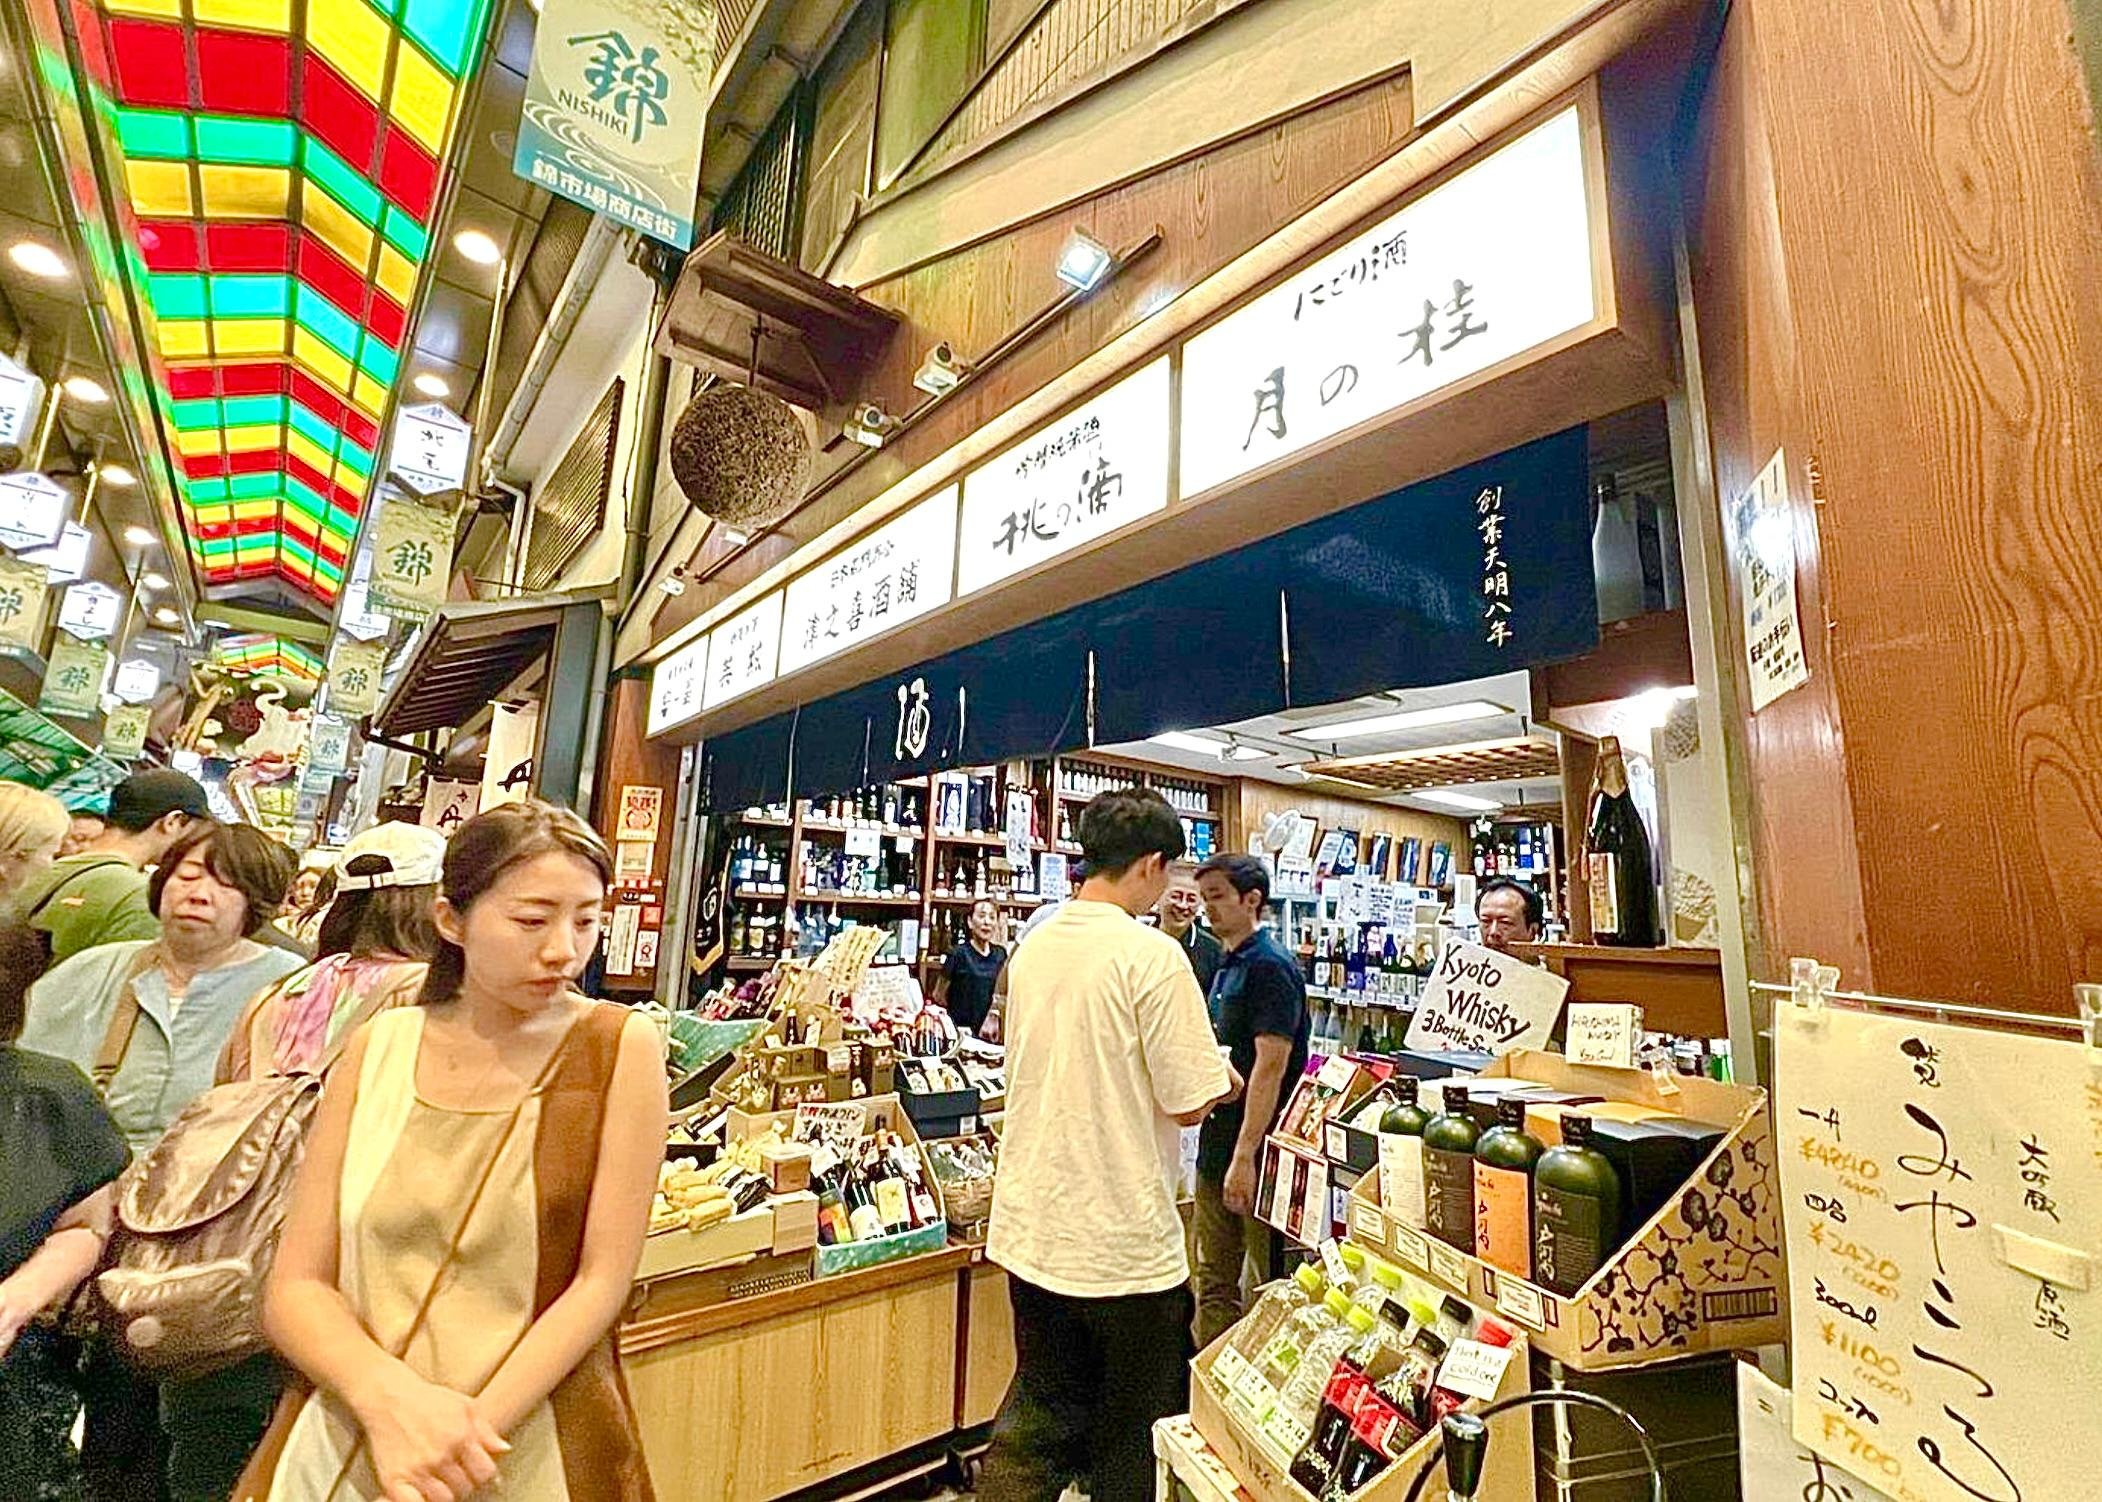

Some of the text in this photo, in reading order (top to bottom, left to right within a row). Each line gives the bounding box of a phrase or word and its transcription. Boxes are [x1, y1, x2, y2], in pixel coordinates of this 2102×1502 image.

[557, 88, 628, 136] NISHIKI
[567, 30, 669, 144] 錦
[532, 158, 678, 239] 錦市場商店街
[1294, 230, 1408, 322] にごり酒
[1242, 278, 1489, 452] 月の桂
[992, 456, 1123, 556] 桃の滴
[385, 540, 433, 587] 錦
[1475, 485, 1514, 648] 創業天明八年
[1439, 943, 1502, 988] Kyoto
[1421, 1008, 1436, 1032] 3
[1446, 989, 1531, 1044] Whisky
[1797, 1107, 1841, 1142] 一升
[1820, 1318, 1902, 1377] ¥1100
[1818, 1377, 1879, 1425] コップ
